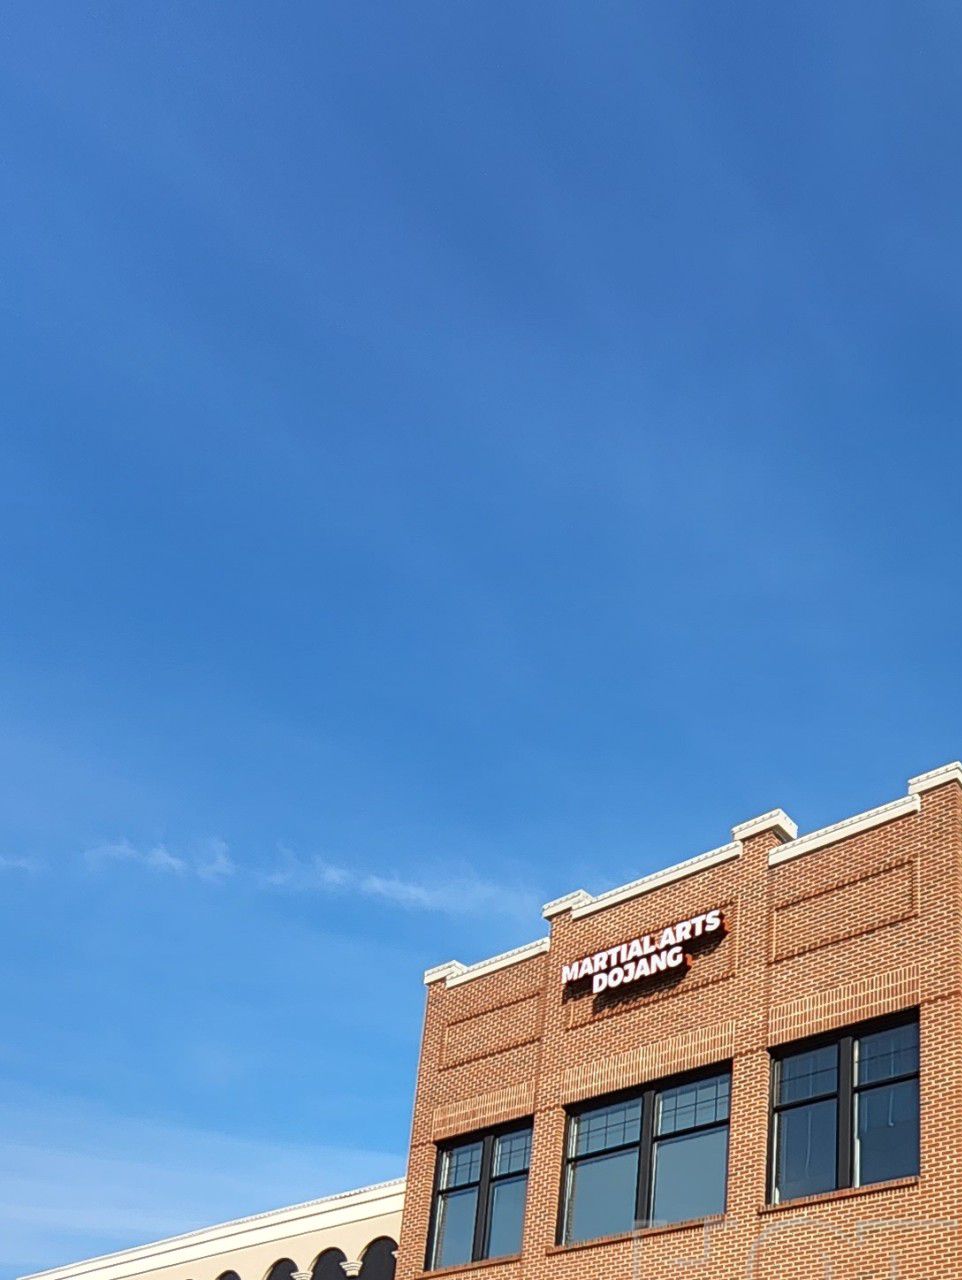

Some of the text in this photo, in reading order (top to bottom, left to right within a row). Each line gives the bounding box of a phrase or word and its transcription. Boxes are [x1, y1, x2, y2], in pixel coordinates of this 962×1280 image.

[561, 909, 721, 984] MARTIAL ARTS
[592, 946, 683, 994] DOJANG
